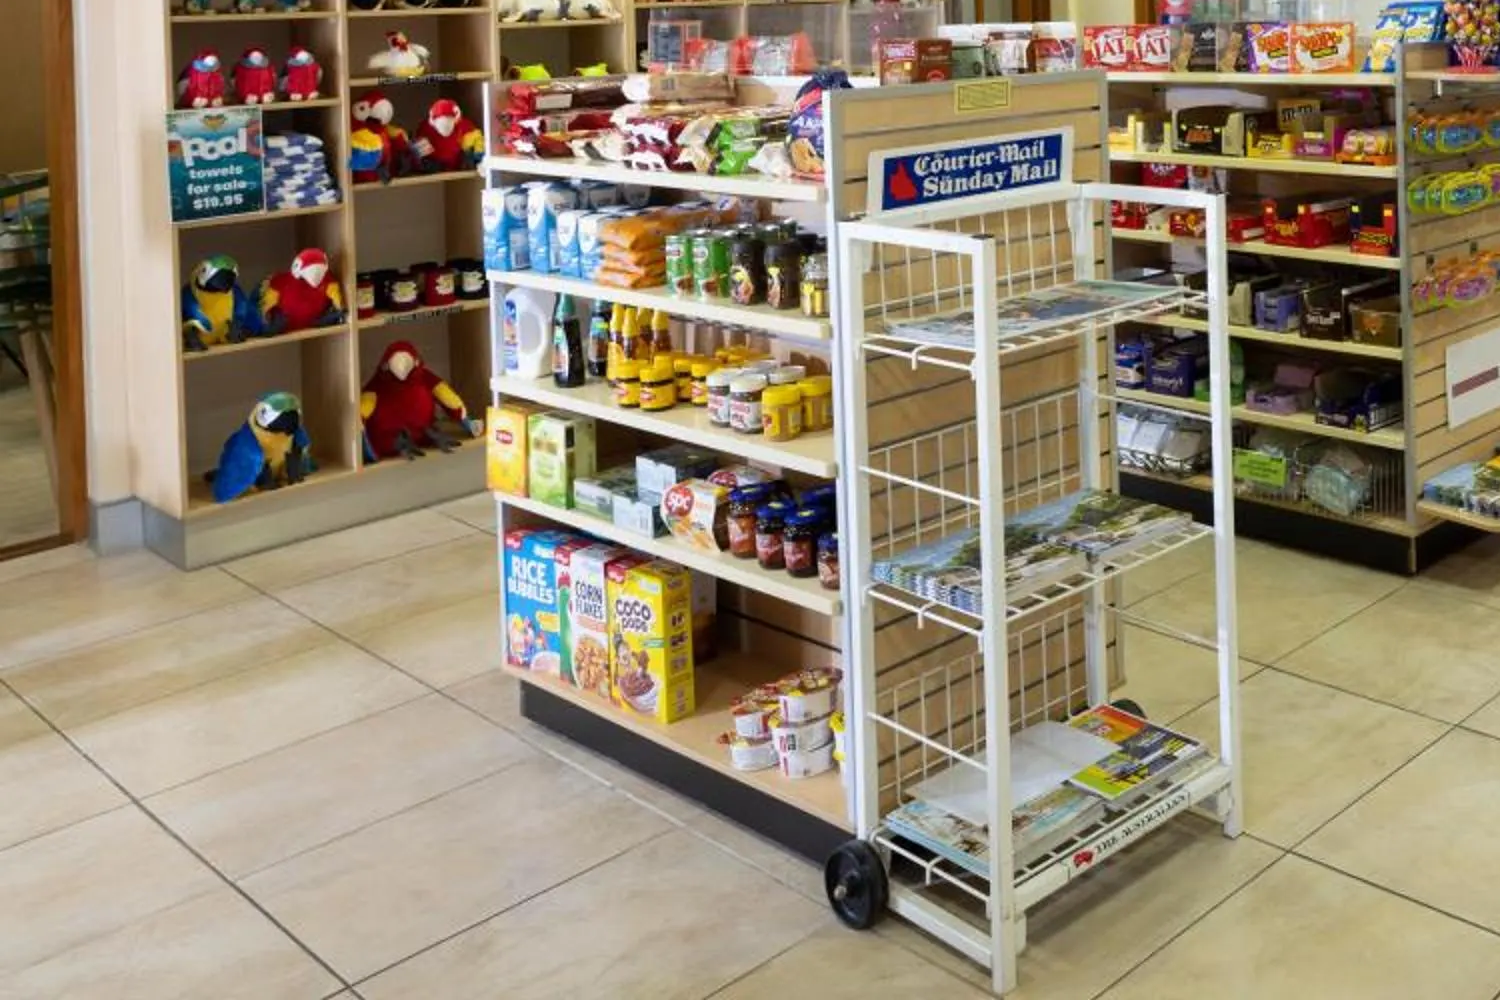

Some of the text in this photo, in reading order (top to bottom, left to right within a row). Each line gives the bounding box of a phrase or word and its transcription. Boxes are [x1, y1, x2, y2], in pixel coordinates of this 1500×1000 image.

[1092, 35, 1124, 60] JAT
[913, 140, 1045, 177] Courier-Mail
[189, 165, 244, 179] towels
[923, 159, 1057, 198] Sunday Mail
[187, 180, 248, 196] for sale
[511, 556, 547, 585] RICE
[508, 576, 554, 605] BUBBLES
[575, 581, 603, 605] CORN
[575, 600, 604, 620] FLAKES
[616, 599, 651, 621] COCO
[1097, 795, 1186, 853] THE AUSTRALIAN
